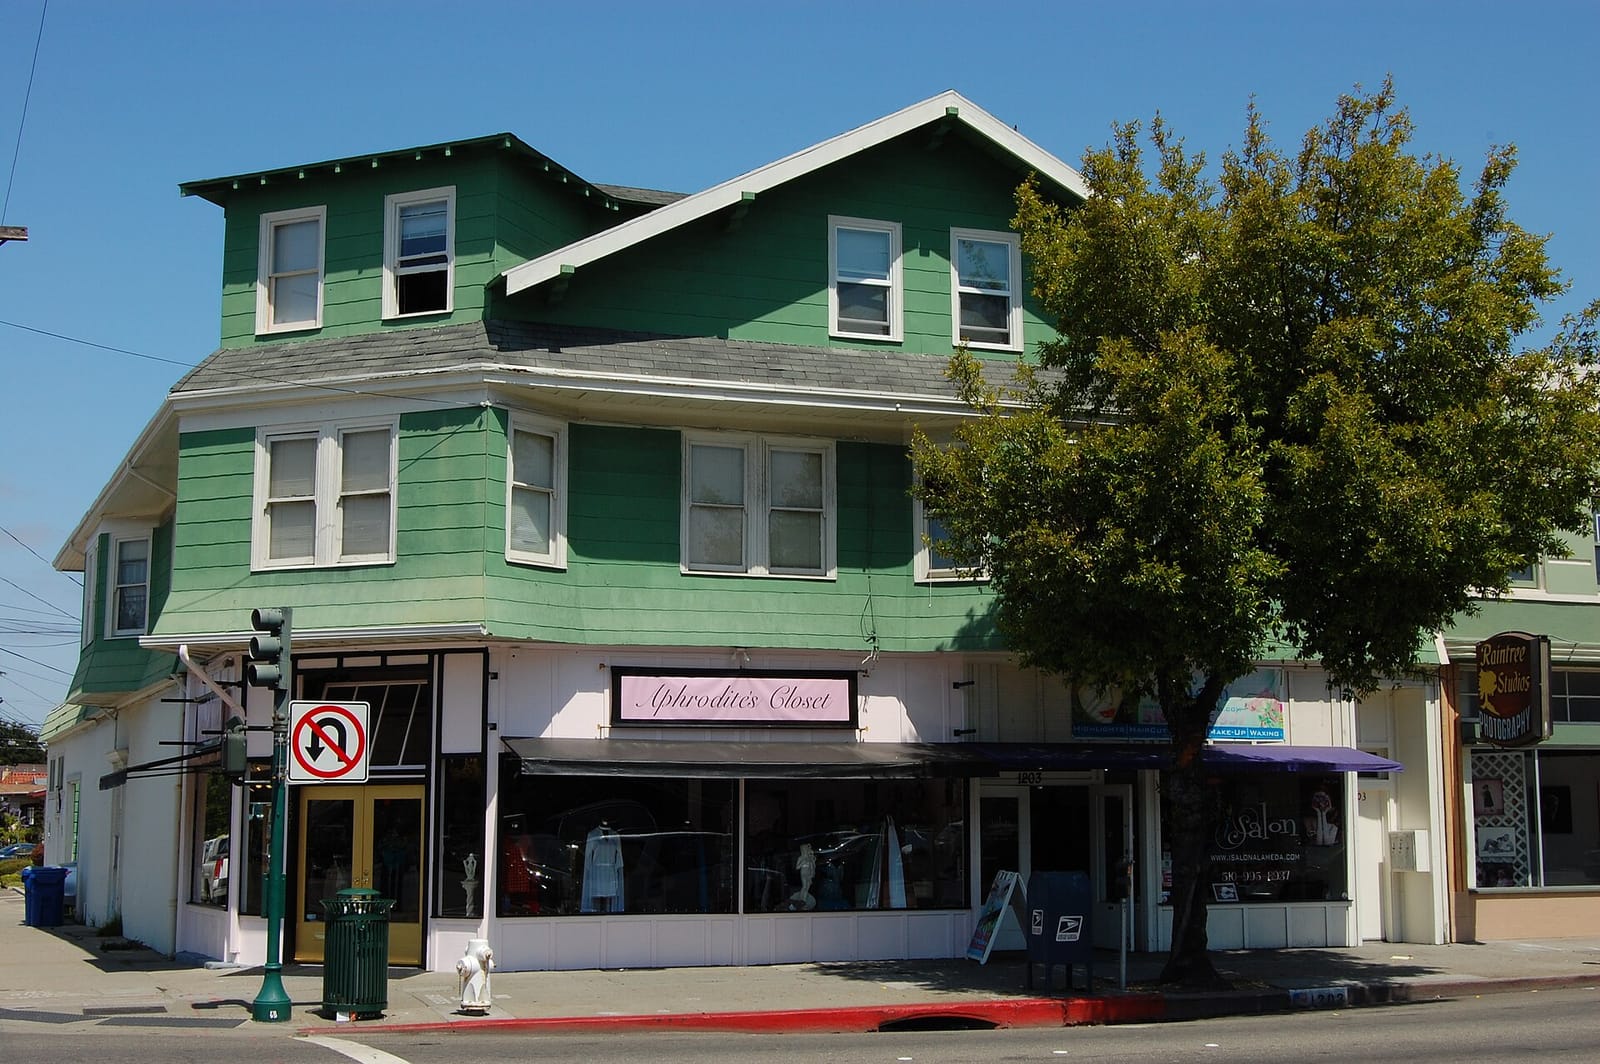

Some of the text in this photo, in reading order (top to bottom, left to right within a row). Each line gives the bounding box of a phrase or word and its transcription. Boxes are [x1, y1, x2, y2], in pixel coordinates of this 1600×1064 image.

[1480, 644, 1526, 666] Raintree
[1497, 672, 1530, 693] Studios
[636, 683, 830, 717] Aphrodite's Closet
[1479, 706, 1531, 740] PHOTOGRAPHY
[1249, 730, 1279, 738] WAXING
[1018, 772, 1042, 784] 1203
